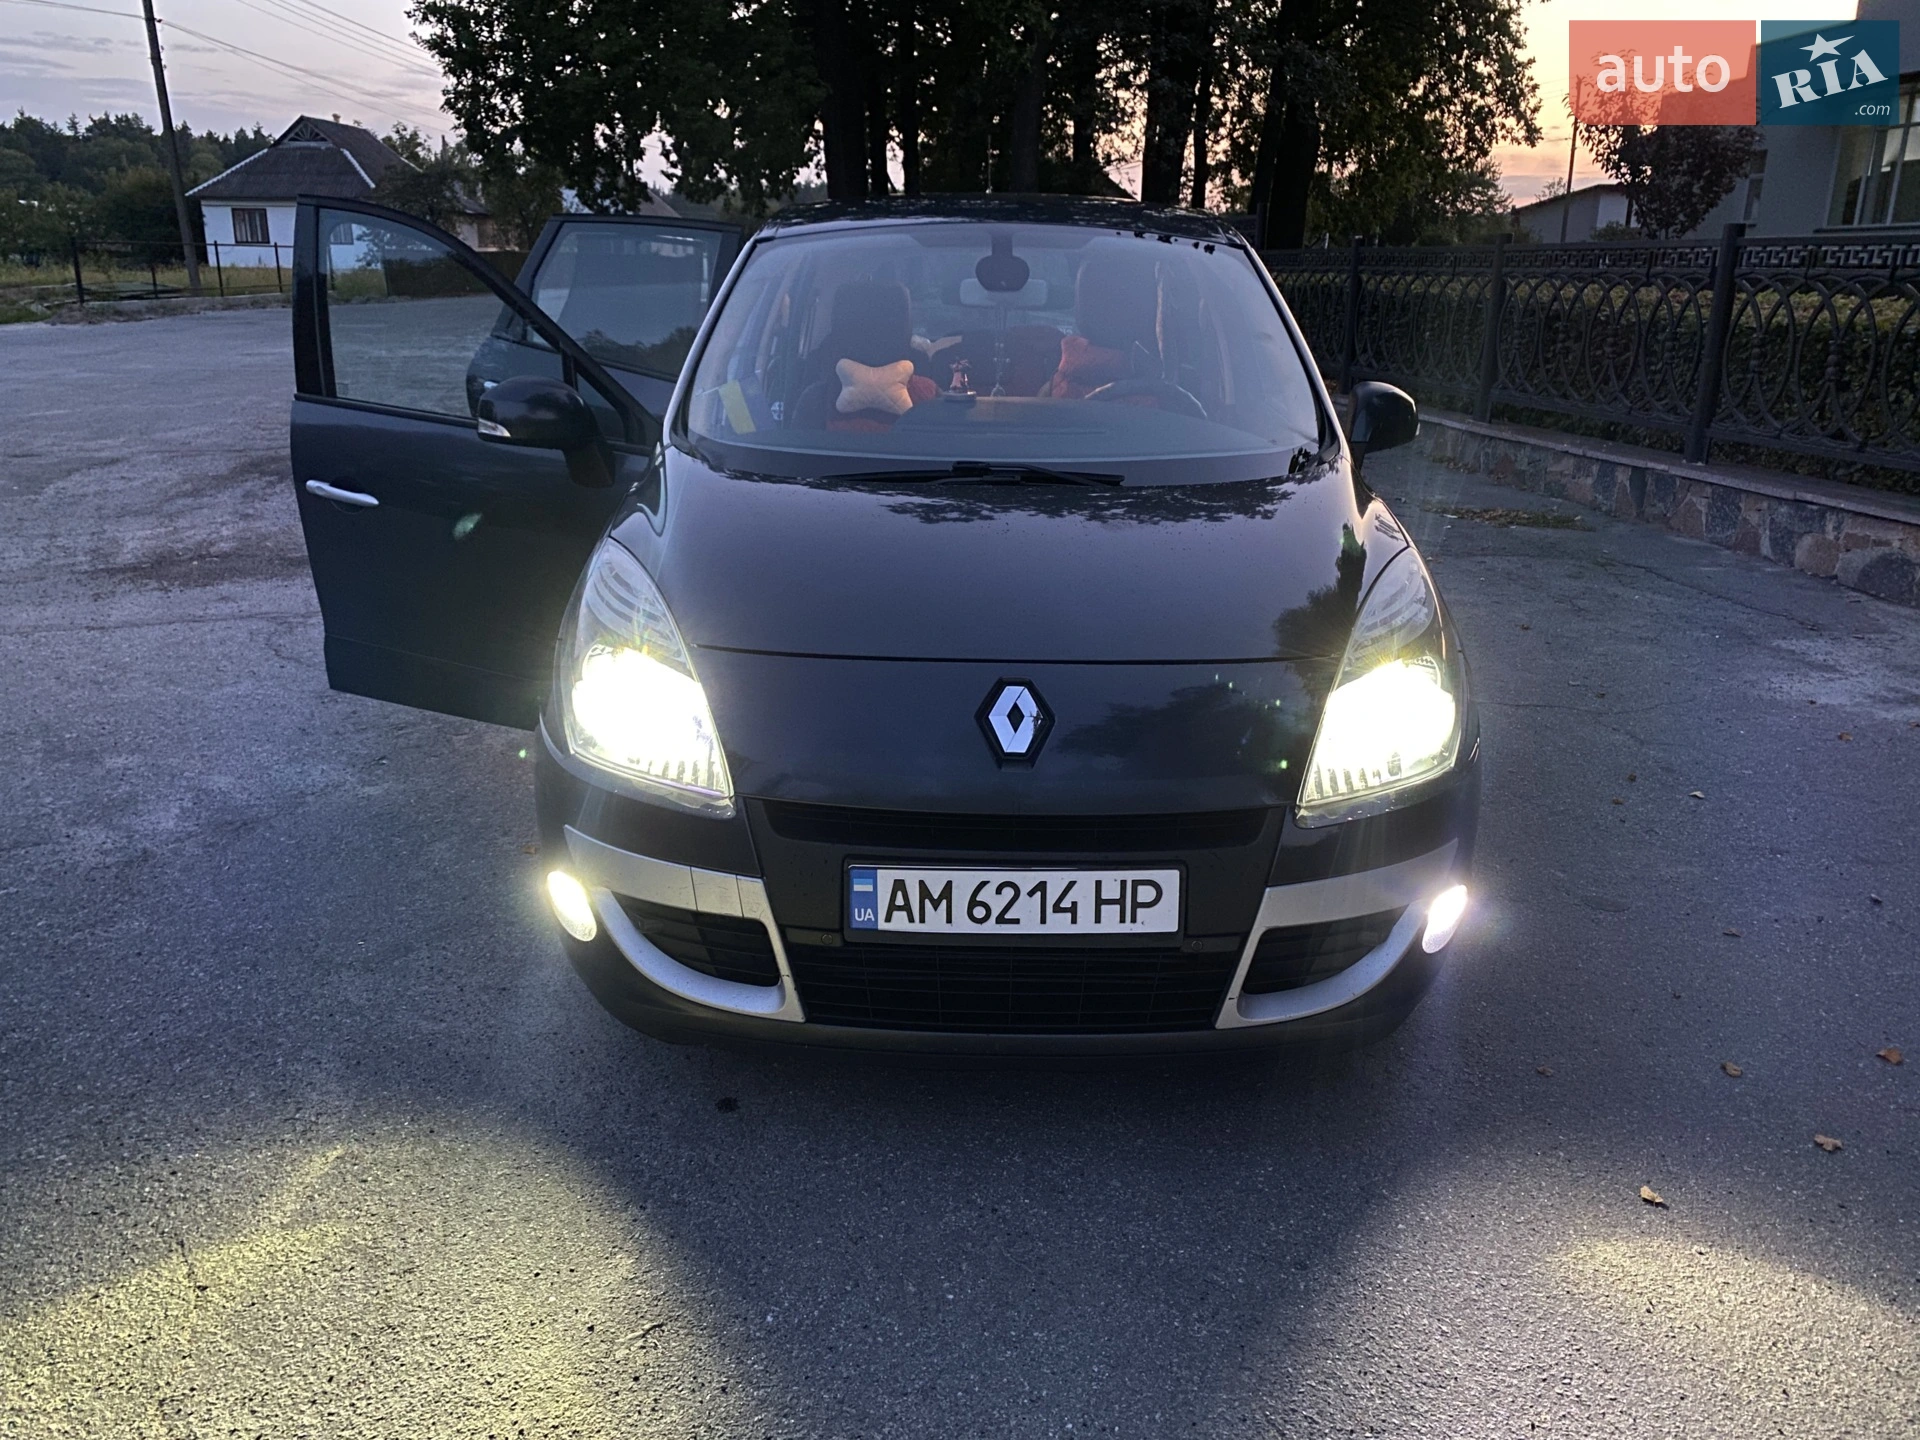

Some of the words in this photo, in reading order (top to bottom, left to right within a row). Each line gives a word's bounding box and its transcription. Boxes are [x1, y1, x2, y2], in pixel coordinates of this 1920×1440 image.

[854, 908, 875, 921] UA
[884, 878, 953, 924] AM
[966, 880, 1078, 925] 6214
[1094, 879, 1163, 924] HP
